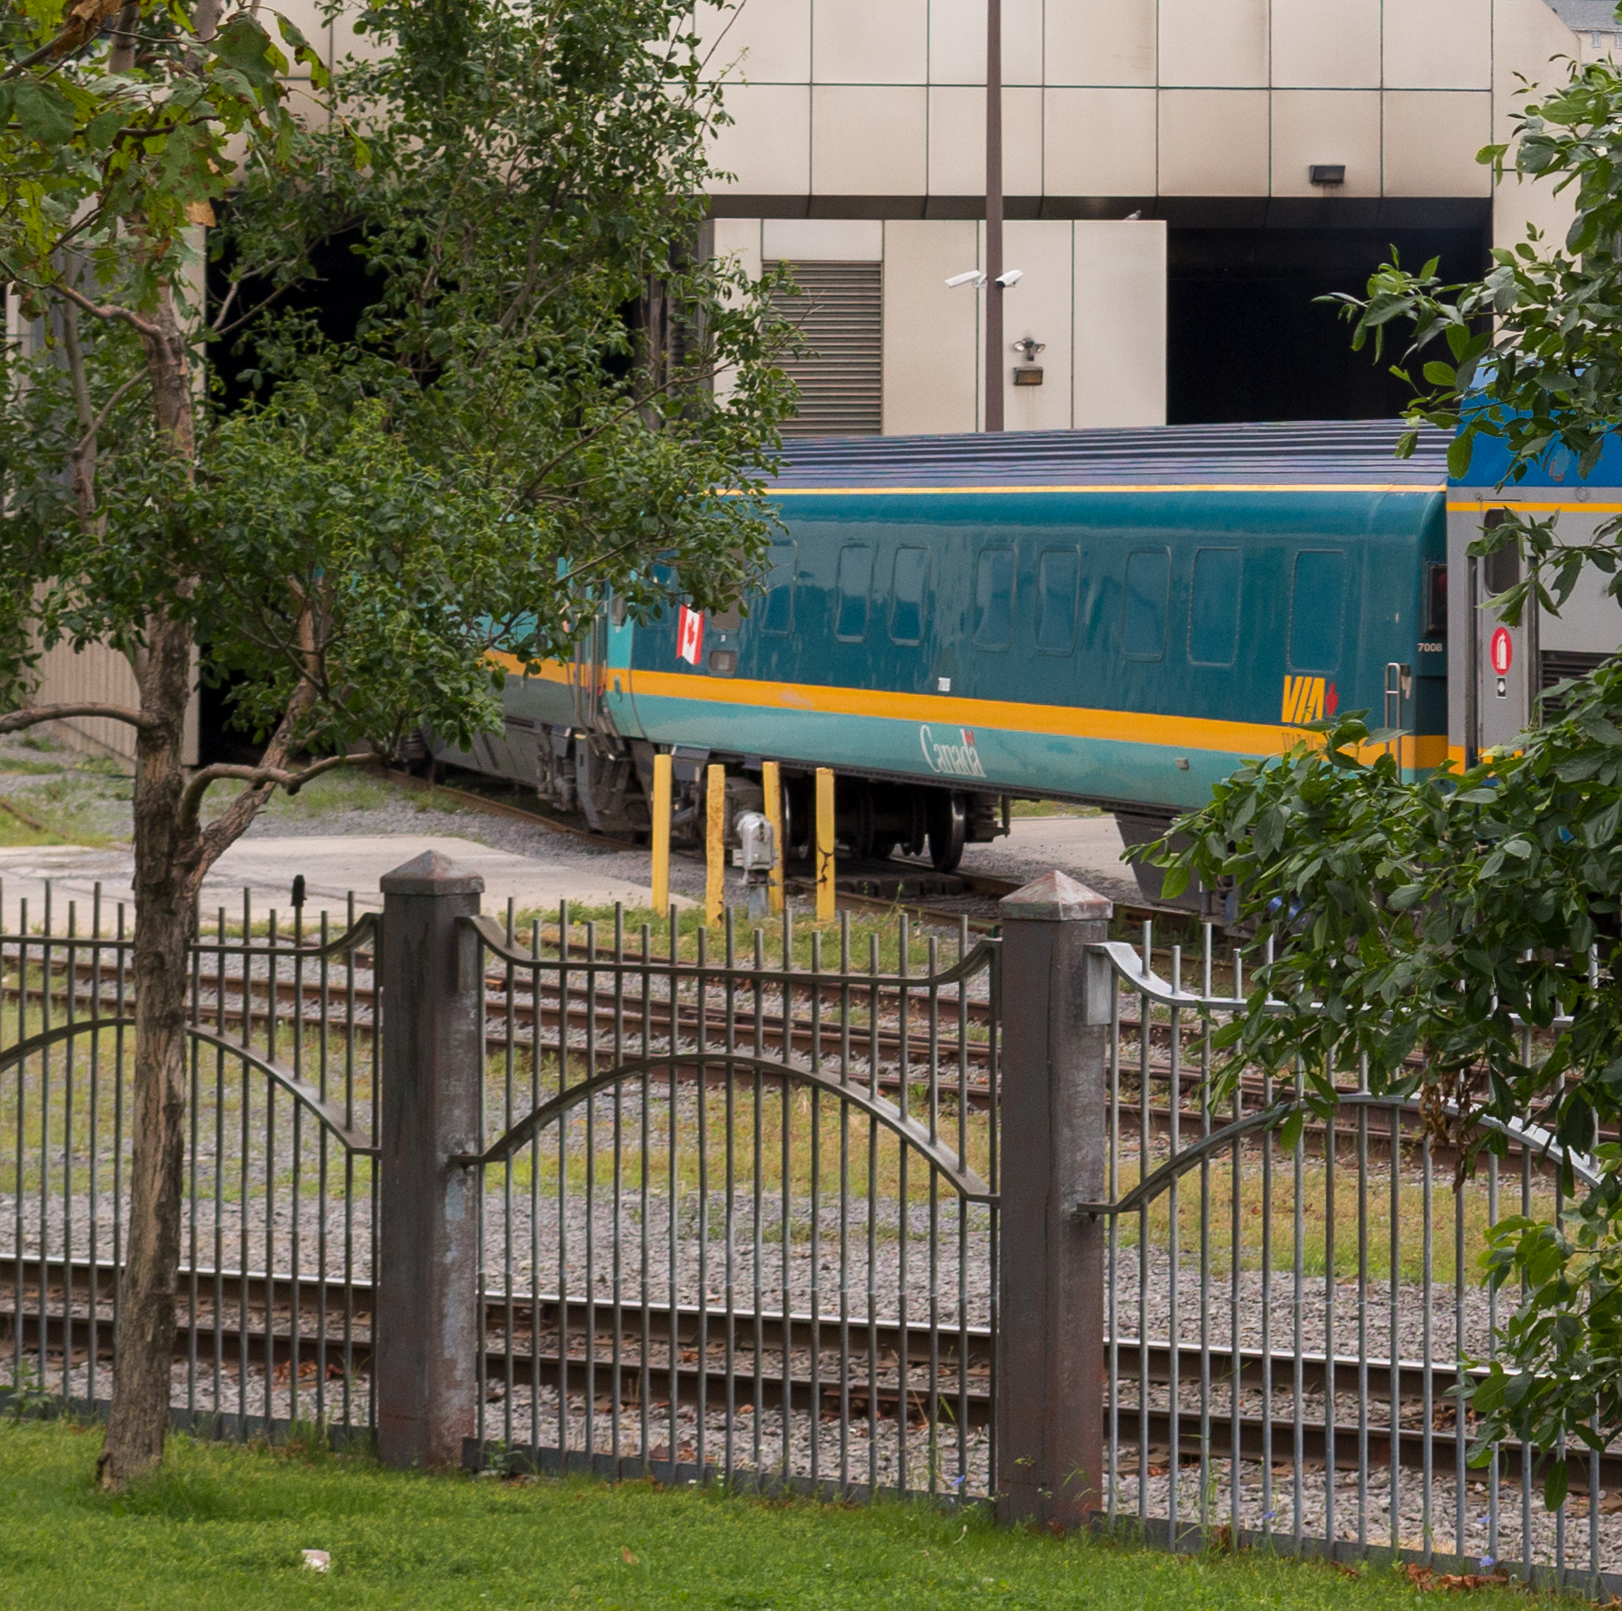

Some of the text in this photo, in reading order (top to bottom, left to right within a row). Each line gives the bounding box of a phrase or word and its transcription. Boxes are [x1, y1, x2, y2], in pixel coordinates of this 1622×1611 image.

[1417, 642, 1443, 652] 7008
[1281, 675, 1326, 725] VIA
[920, 723, 987, 778] Canada
